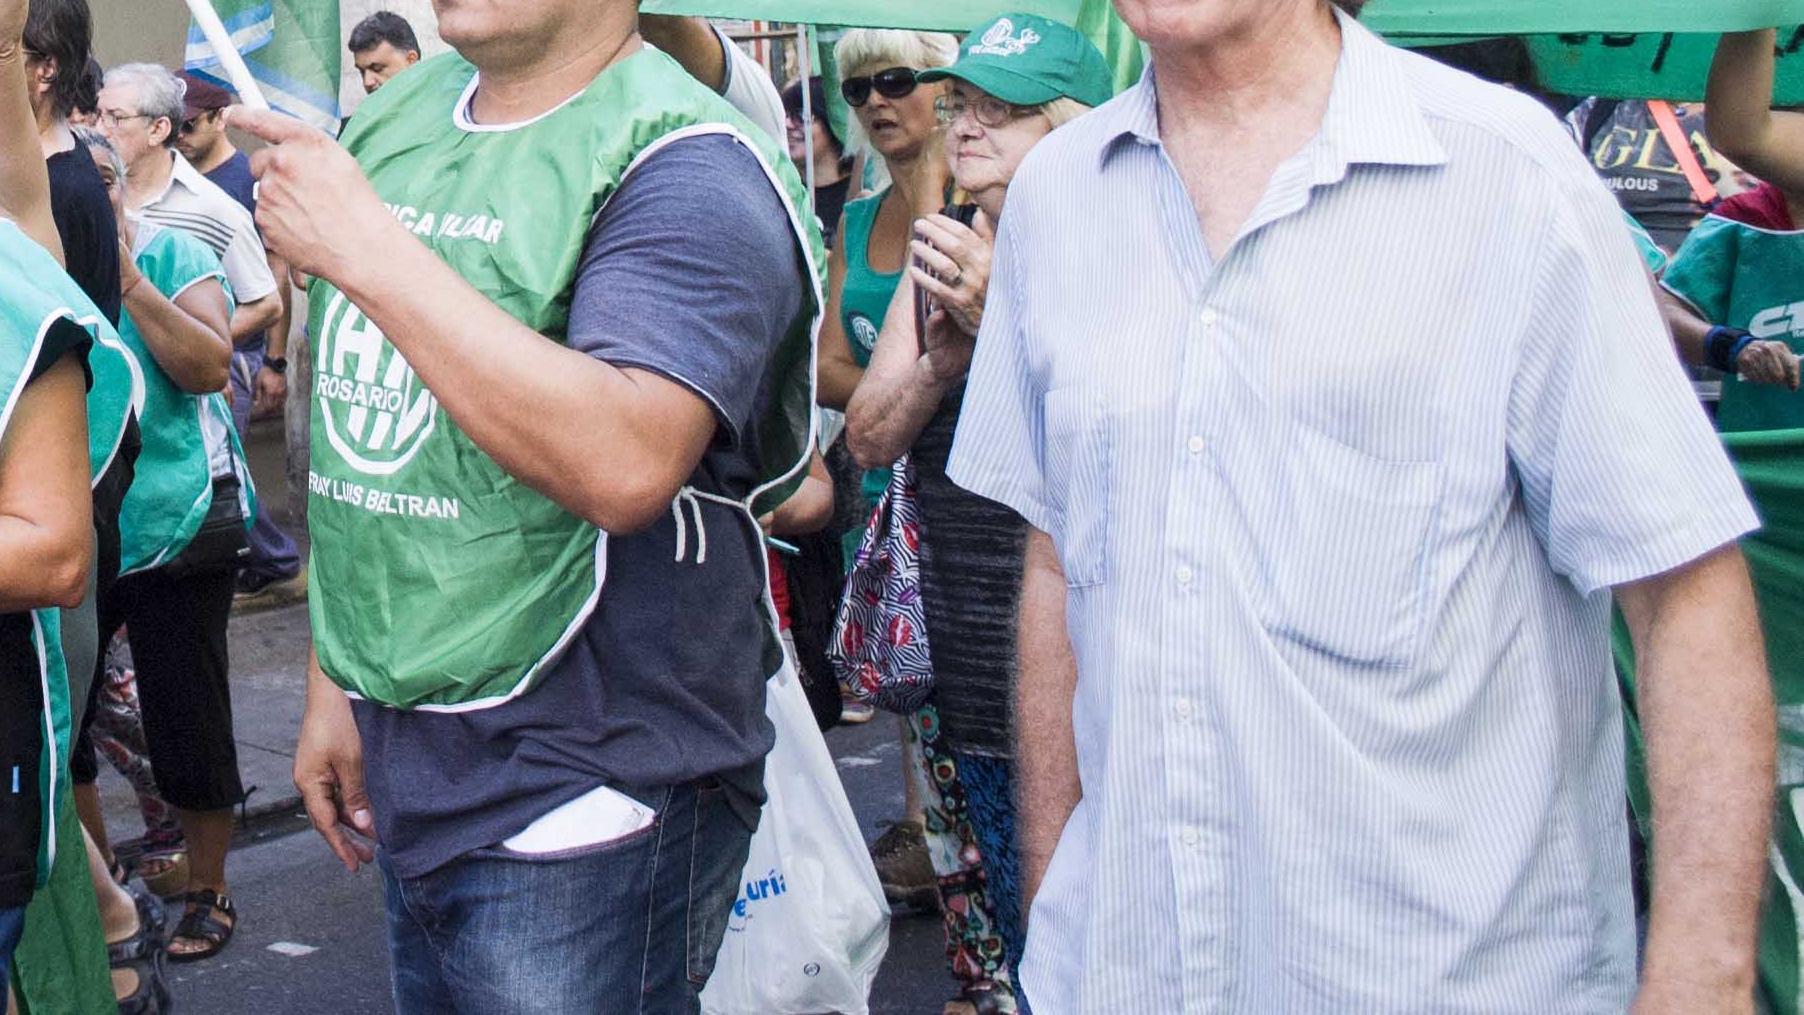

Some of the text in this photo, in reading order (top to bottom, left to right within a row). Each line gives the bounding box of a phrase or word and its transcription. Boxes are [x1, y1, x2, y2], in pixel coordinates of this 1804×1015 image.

[317, 373, 404, 413] ROSARIO
[308, 471, 460, 519] FRAY LUIS BELTRAN
